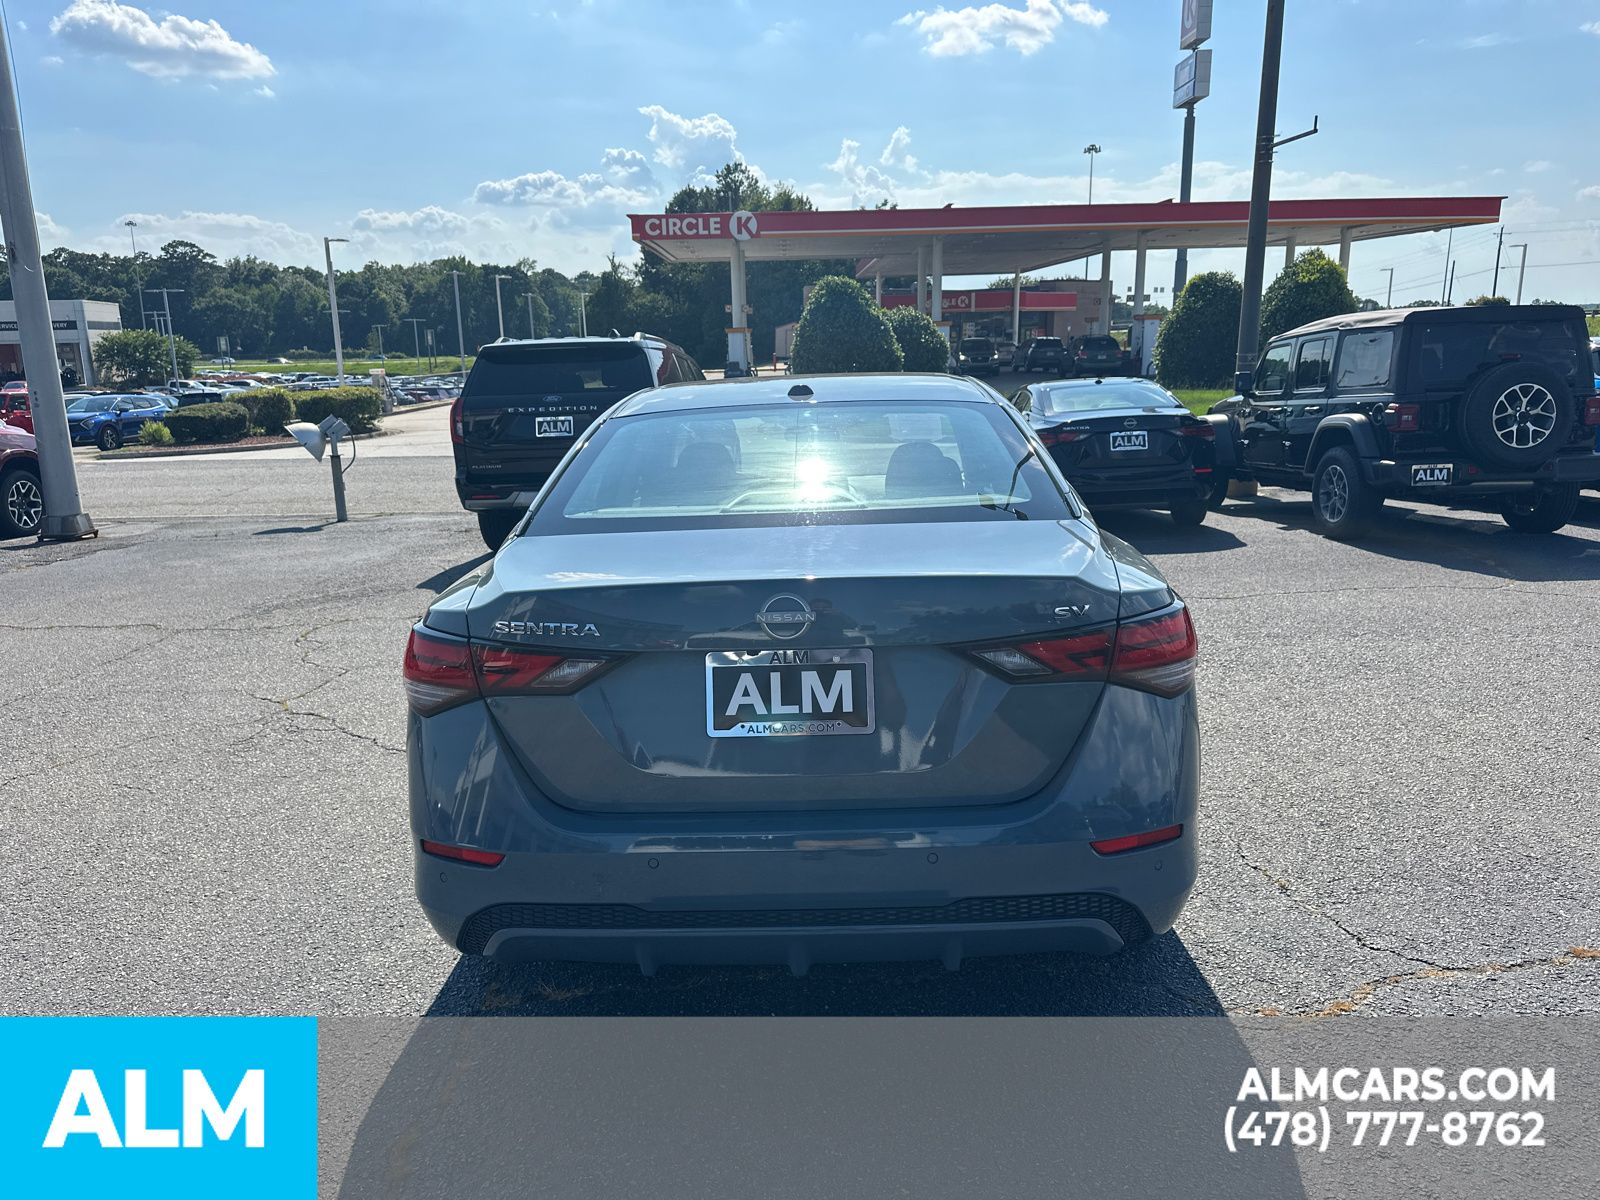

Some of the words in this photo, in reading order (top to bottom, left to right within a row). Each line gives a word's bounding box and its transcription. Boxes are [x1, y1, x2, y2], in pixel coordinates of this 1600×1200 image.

[645, 217, 721, 236] CIRCLE
[734, 213, 756, 239] K
[508, 405, 598, 413] EXPEDITION
[540, 421, 570, 432] ALM
[1115, 435, 1144, 446] ALM
[1415, 469, 1448, 481] ALM
[756, 613, 815, 622] NISSAN
[1054, 604, 1090, 619] SV
[495, 621, 600, 636] SENTRA
[769, 650, 809, 664] ALM
[725, 669, 853, 716] ALM
[747, 723, 835, 734] ALMCARS.COM
